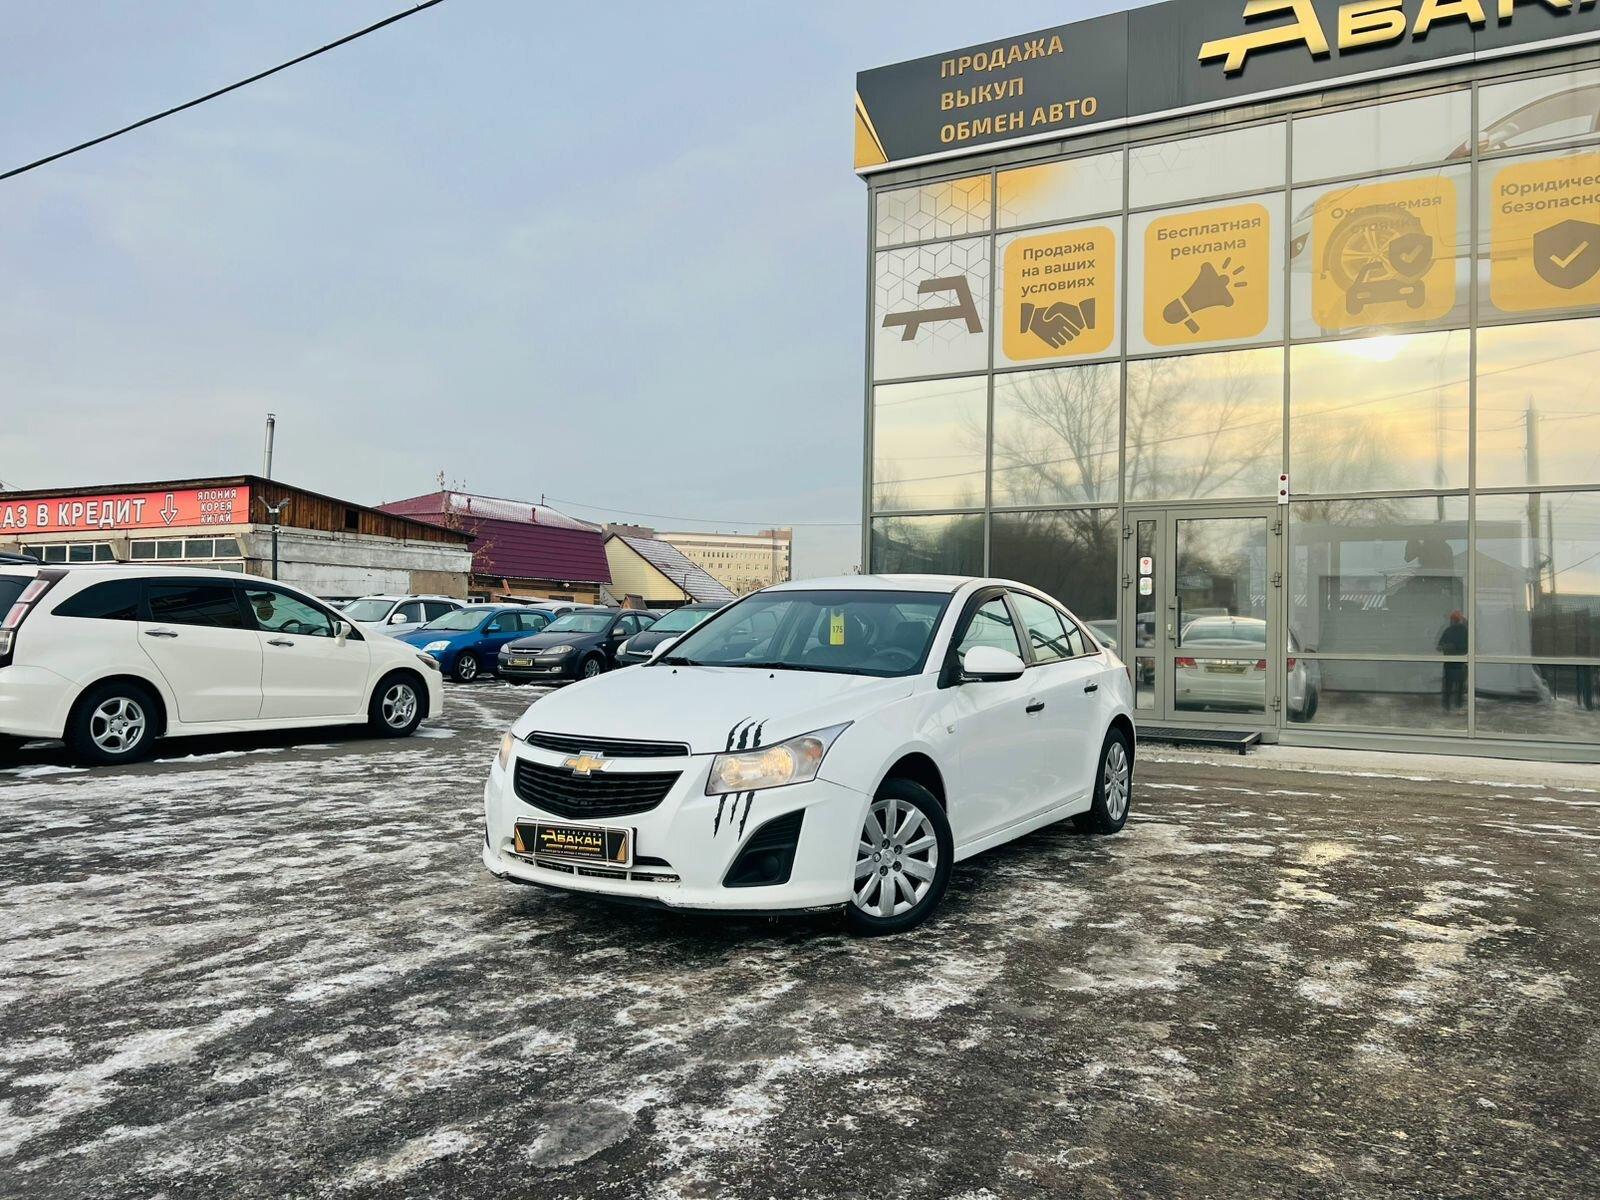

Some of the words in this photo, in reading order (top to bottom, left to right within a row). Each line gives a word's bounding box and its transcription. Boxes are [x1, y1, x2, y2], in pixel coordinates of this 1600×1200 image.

[941, 35, 1064, 78] ПРОДАЖА
[941, 77, 1024, 111] ВЫКУП
[940, 110, 1024, 143] ОБМЕН
[1031, 96, 1097, 126] АВТО
[1157, 217, 1261, 241] Бесплатная
[1023, 240, 1095, 261] Продажа
[1170, 238, 1246, 260] реклама
[1021, 265, 1040, 278] на
[1044, 258, 1095, 276] ваших
[1021, 276, 1095, 297] условиях
[197, 489, 237, 500] ЯПОНИЯ
[0, 504, 28, 528] АЗ
[36, 503, 49, 526] В
[58, 498, 146, 529] КРЕДИТ
[201, 501, 232, 511] КОРЕЯ
[201, 511, 231, 523] КИТАЙ
[832, 625, 843, 633] 175
[541, 829, 602, 846] АБАКАН
